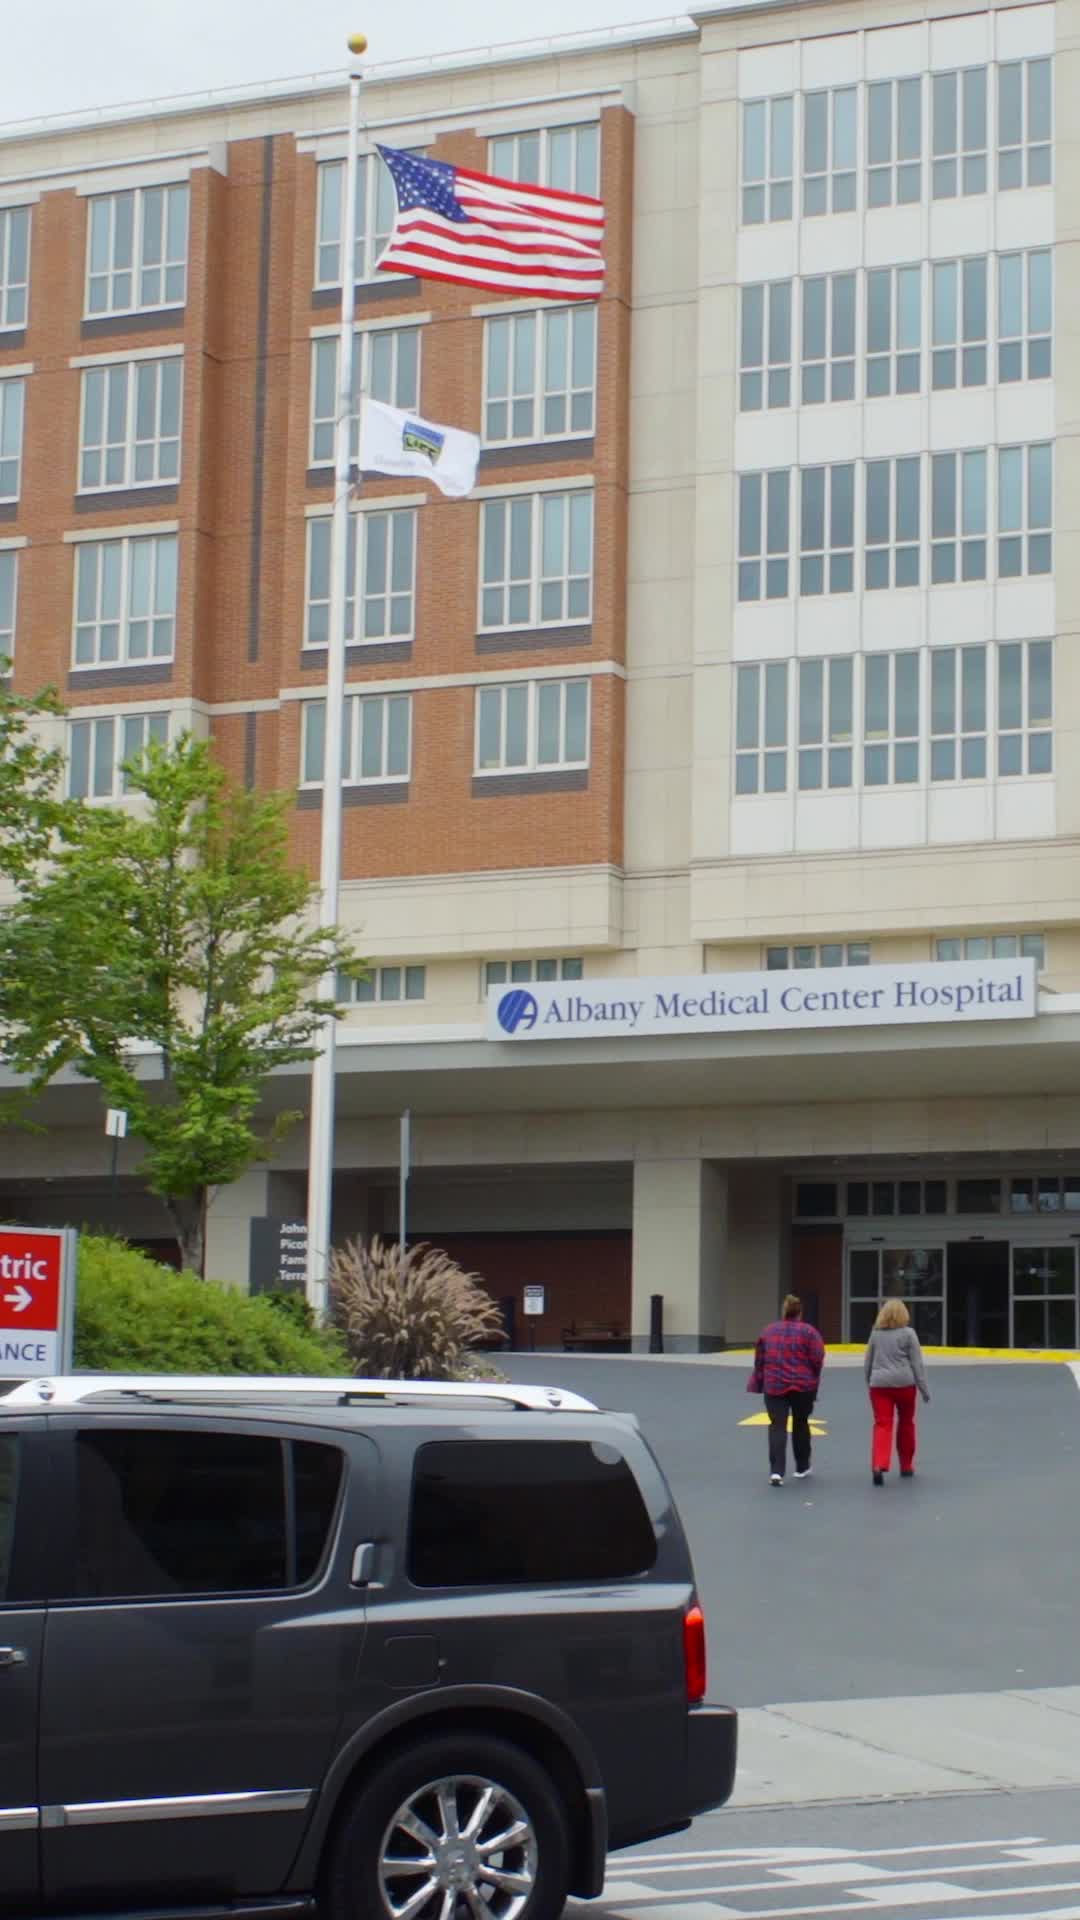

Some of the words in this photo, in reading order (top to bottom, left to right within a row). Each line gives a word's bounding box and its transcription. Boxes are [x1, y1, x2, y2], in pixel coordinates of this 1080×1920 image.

[543, 997, 646, 1027] Albany
[654, 988, 769, 1018] Medical
[780, 986, 885, 1012] Center
[893, 975, 1024, 1012] Hospital
[280, 1223, 308, 1234] John
[0, 1252, 48, 1280] tric
[0, 1343, 47, 1361] NCE
